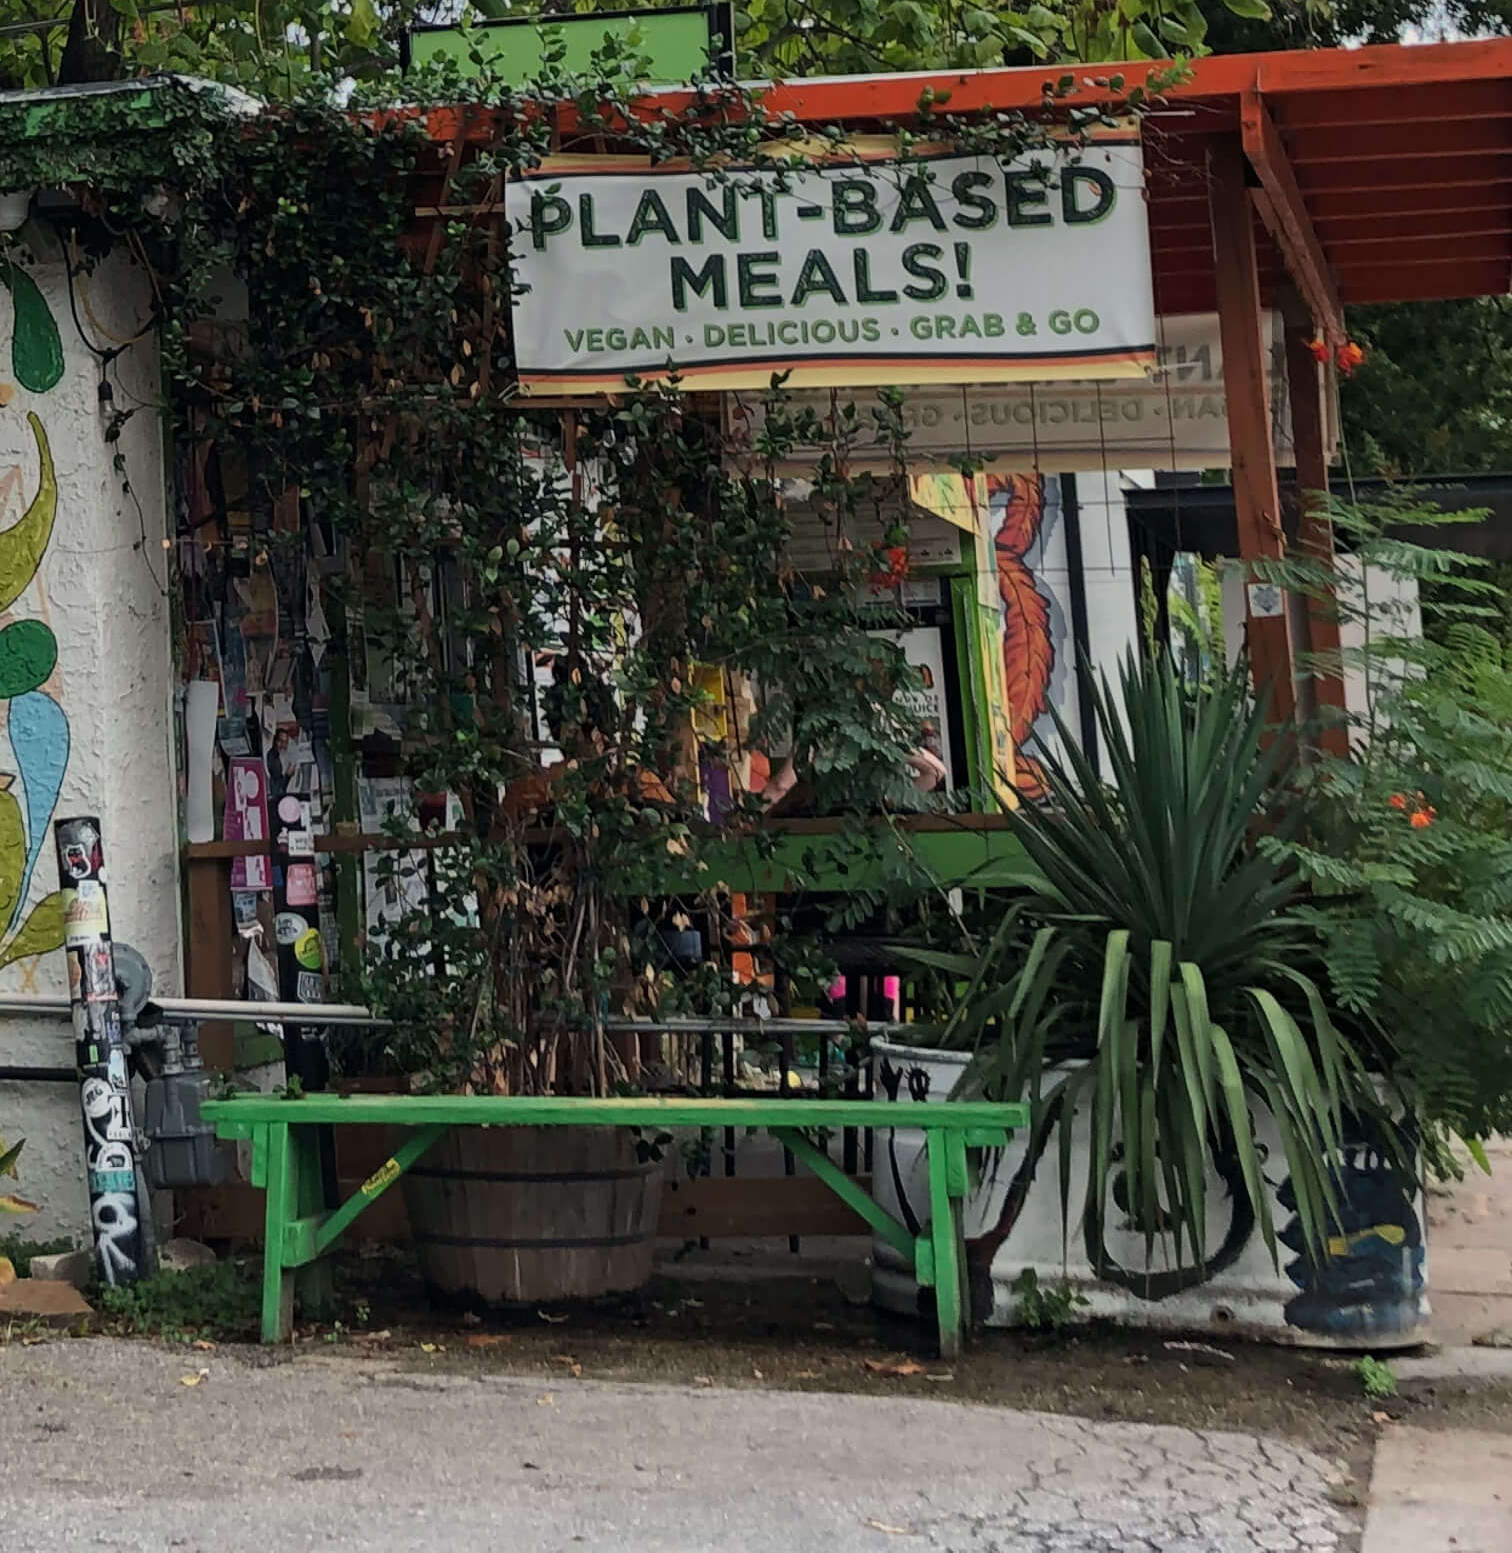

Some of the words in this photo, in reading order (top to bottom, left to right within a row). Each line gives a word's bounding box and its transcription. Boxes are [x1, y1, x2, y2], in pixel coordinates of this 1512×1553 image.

[530, 167, 1118, 251] PLANT-BASED
[670, 242, 975, 313] MEALS!
[564, 326, 675, 353] VEGAN
[703, 318, 882, 347] DELICIOUS
[910, 311, 1006, 340] GRAB
[1015, 311, 1037, 336] &
[1048, 307, 1101, 336] GO
